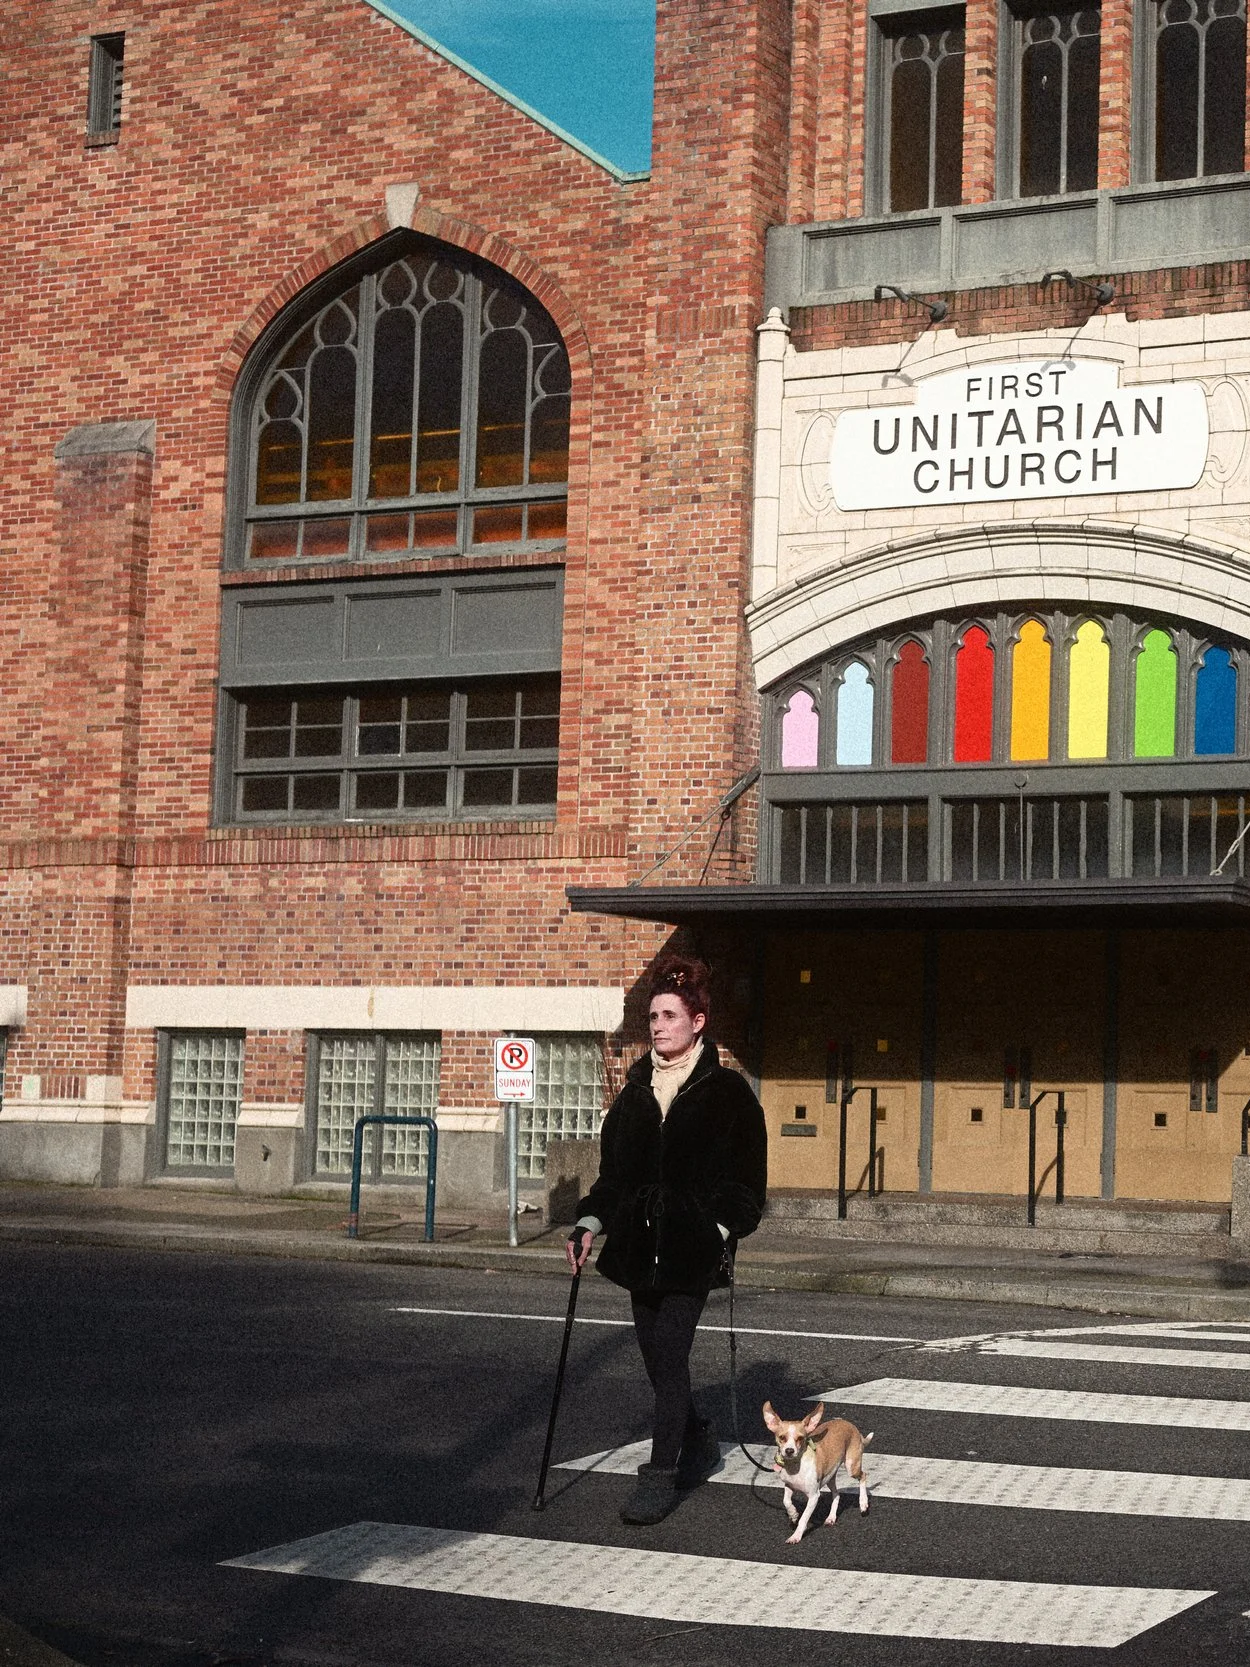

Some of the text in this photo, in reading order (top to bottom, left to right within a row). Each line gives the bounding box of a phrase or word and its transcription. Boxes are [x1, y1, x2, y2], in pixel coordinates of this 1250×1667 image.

[966, 370, 1068, 403] FIRST
[872, 396, 1164, 456] UNITARIAN
[913, 447, 1118, 494] CHURCH
[498, 1078, 532, 1088] SUNDAY
